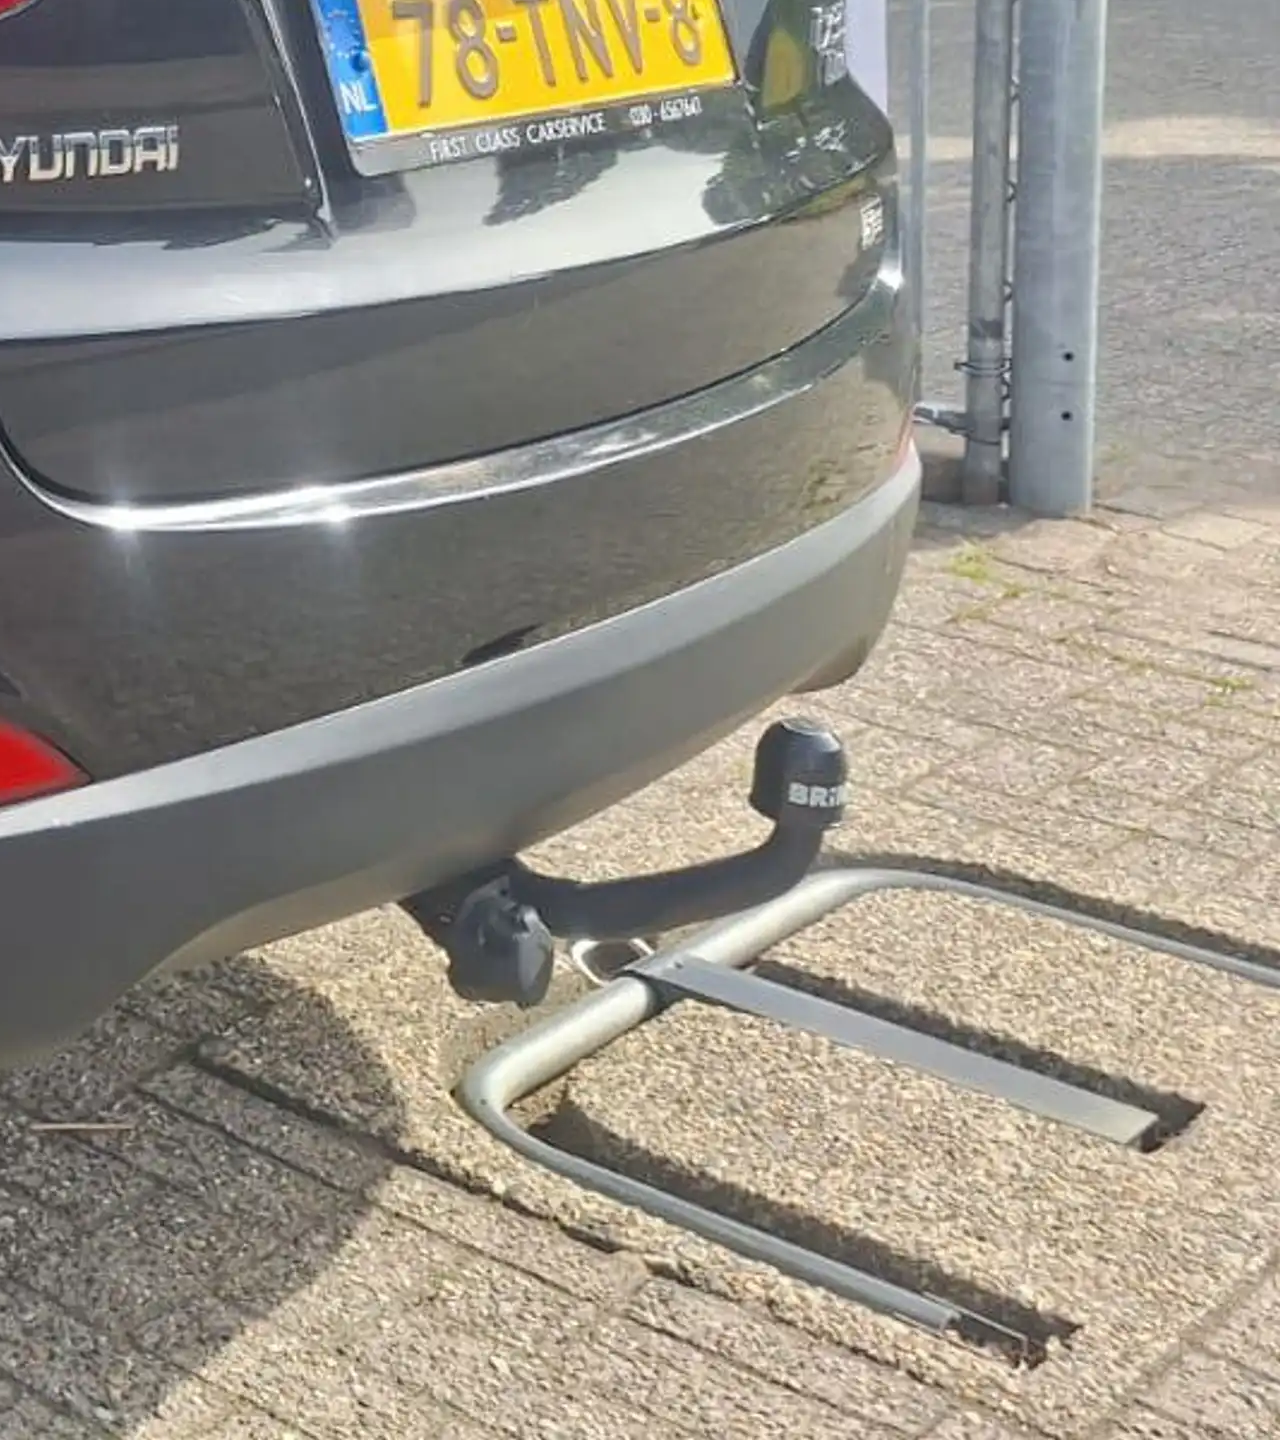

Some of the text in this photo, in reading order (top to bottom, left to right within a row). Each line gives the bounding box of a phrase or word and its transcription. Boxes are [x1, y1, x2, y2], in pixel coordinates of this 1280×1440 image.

[340, 80, 378, 114] NL
[429, 135, 467, 161] FIRST
[476, 127, 521, 153] CLASS
[527, 113, 607, 144] CARSERVICE
